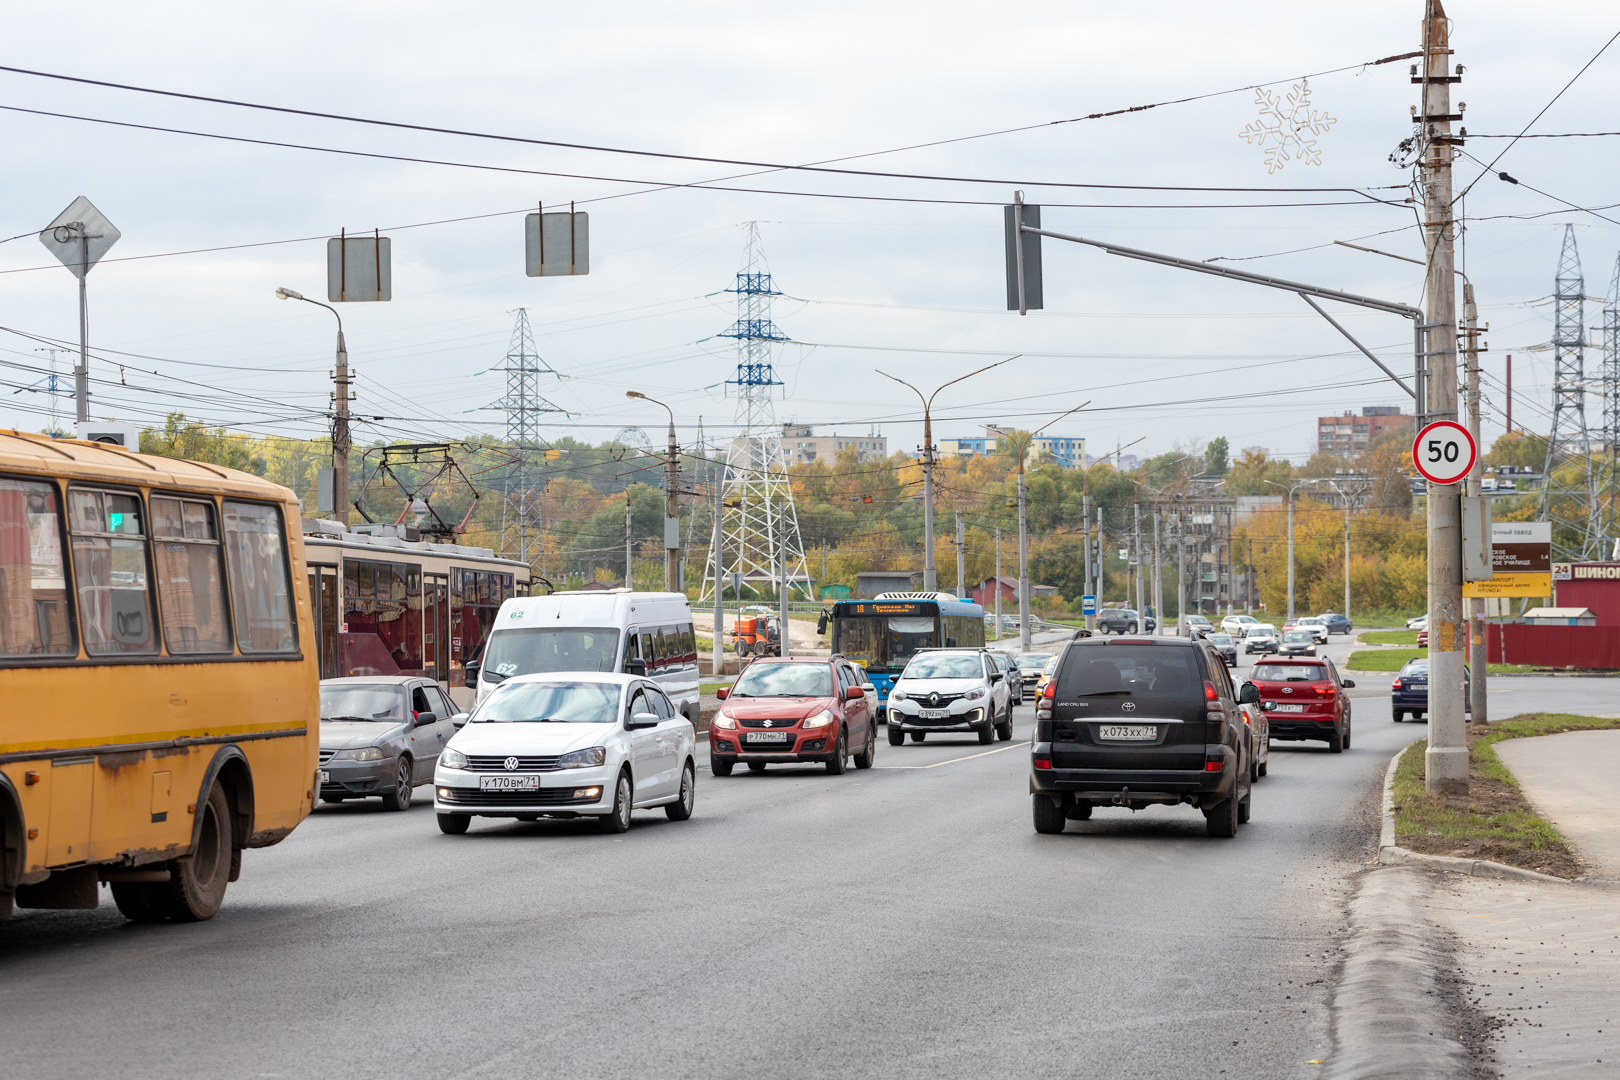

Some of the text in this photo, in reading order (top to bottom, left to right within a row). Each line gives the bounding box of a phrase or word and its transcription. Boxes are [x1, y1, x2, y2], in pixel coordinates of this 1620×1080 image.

[1428, 440, 1459, 463] 50
[1554, 565, 1569, 574] 24
[510, 611, 524, 619] 62
[495, 662, 518, 676] 62
[1103, 727, 1155, 737] Х073ХХ 71
[484, 776, 536, 788] У170ВМ 71
